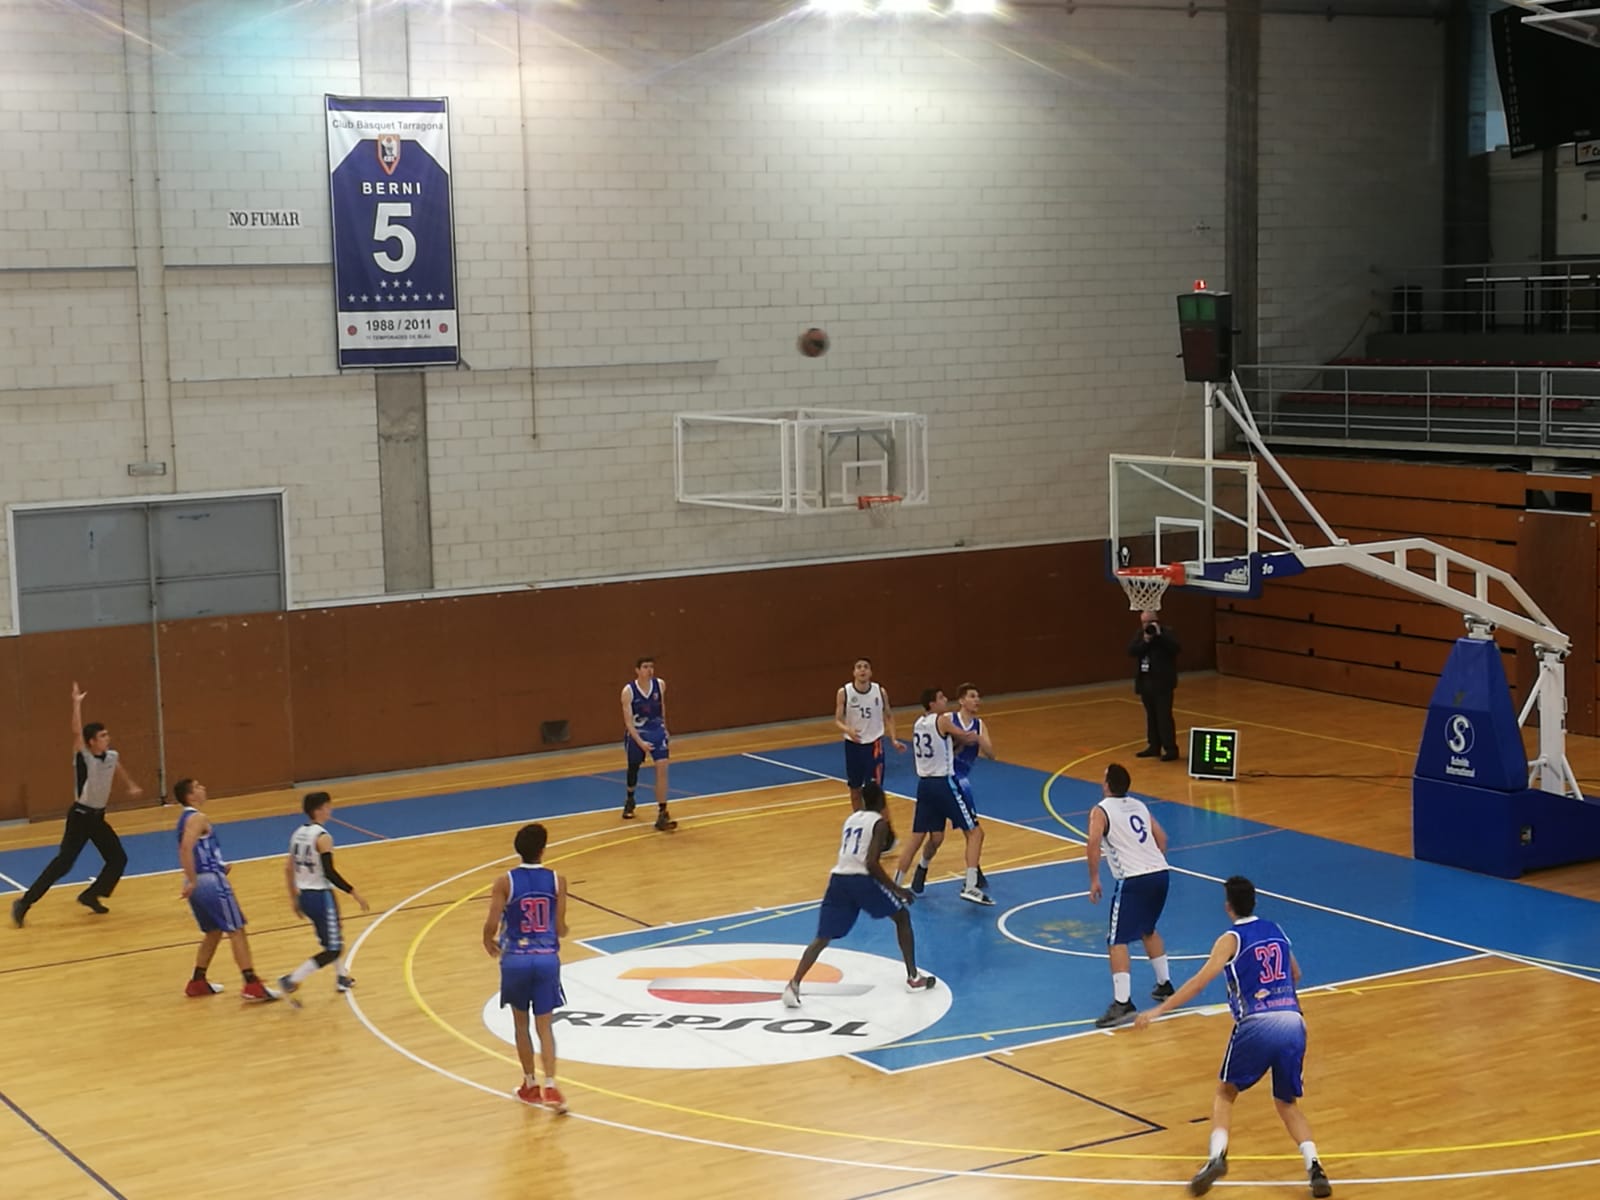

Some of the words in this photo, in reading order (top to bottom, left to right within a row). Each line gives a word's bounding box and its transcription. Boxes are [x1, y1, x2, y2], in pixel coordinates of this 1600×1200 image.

[332, 119, 354, 129] Club
[399, 121, 444, 132] Tarragona
[362, 181, 421, 195] BERNI
[229, 211, 249, 227] NO
[250, 211, 300, 227] FUMAR
[373, 202, 417, 274] 5
[366, 319, 395, 331] 1988
[404, 318, 431, 330] 2011
[859, 707, 872, 719] 15
[913, 732, 935, 758] 33
[1205, 734, 1232, 763] 15
[1129, 815, 1147, 843] 9
[520, 897, 551, 933] 30
[1254, 942, 1287, 984] 32
[552, 1010, 869, 1037] REPSOL
